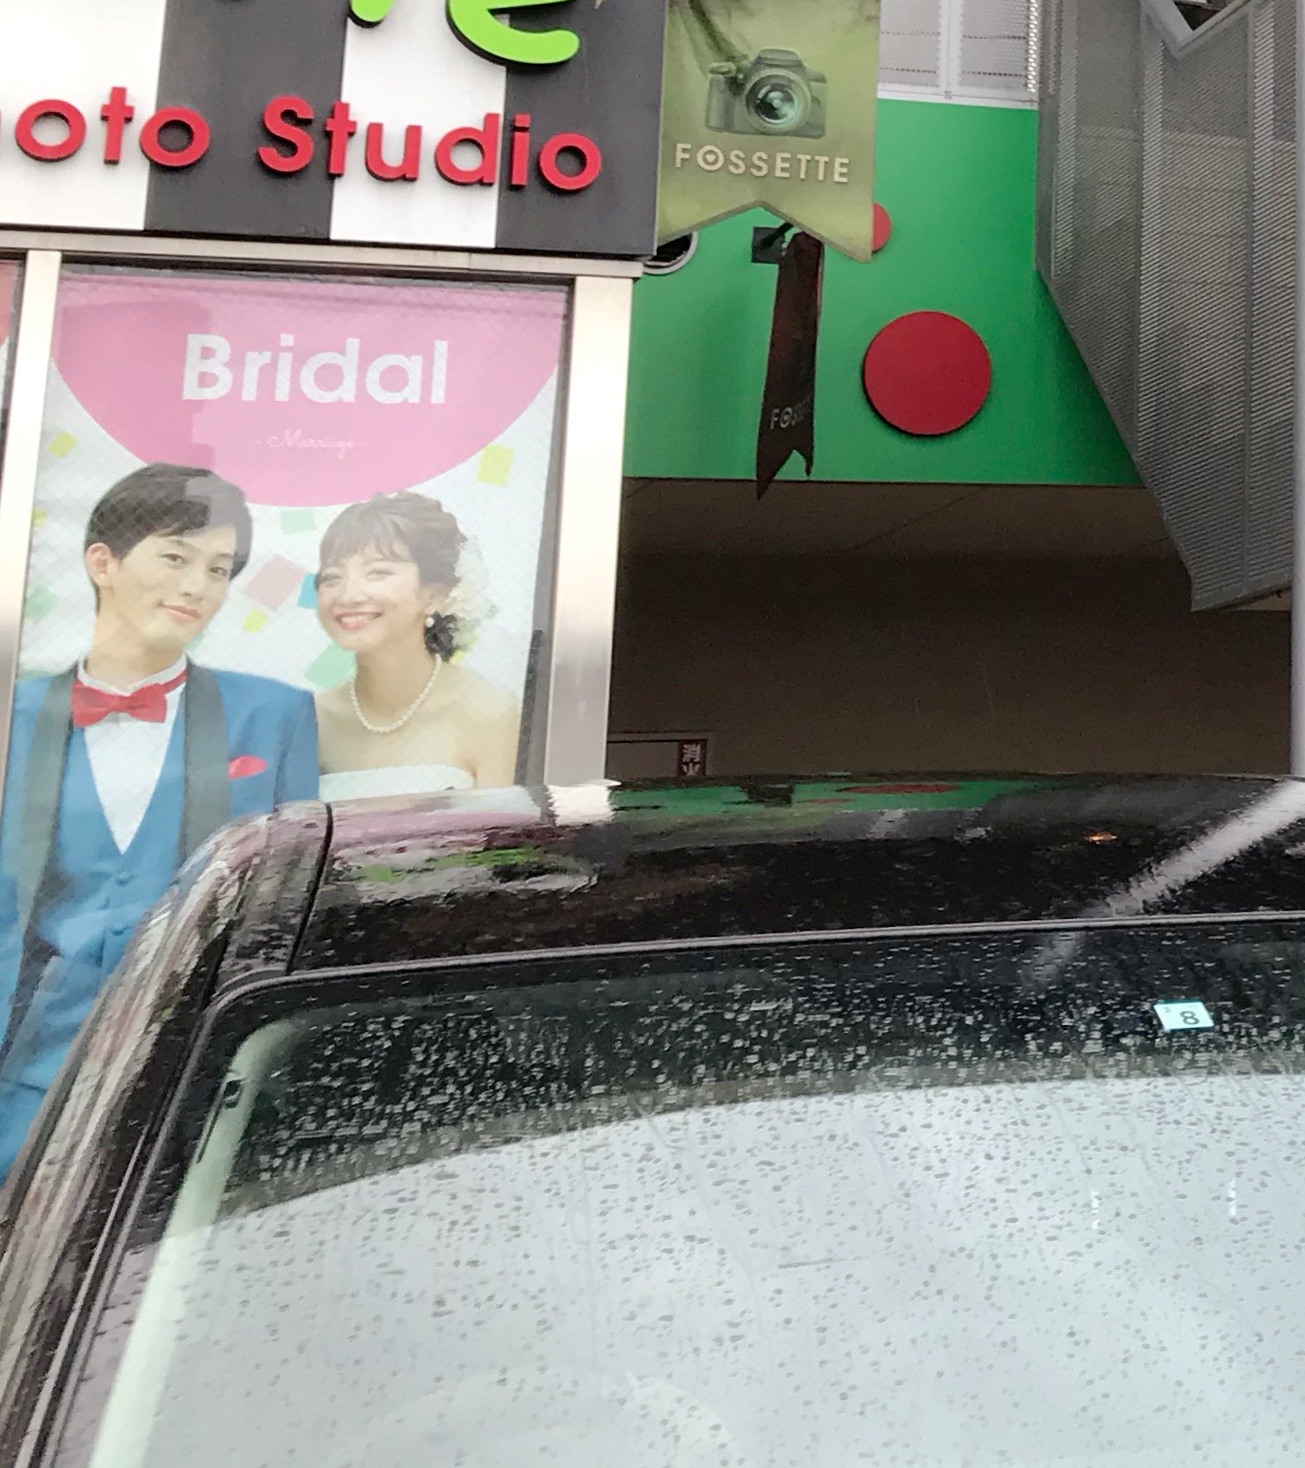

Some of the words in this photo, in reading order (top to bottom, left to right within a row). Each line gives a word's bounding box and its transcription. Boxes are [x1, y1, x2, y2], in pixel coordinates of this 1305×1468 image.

[12, 86, 211, 168] oto
[257, 94, 603, 192] Studio
[674, 142, 850, 183] FOSSETTE
[181, 332, 450, 406] Bridal
[1180, 1010, 1200, 1026] 8
